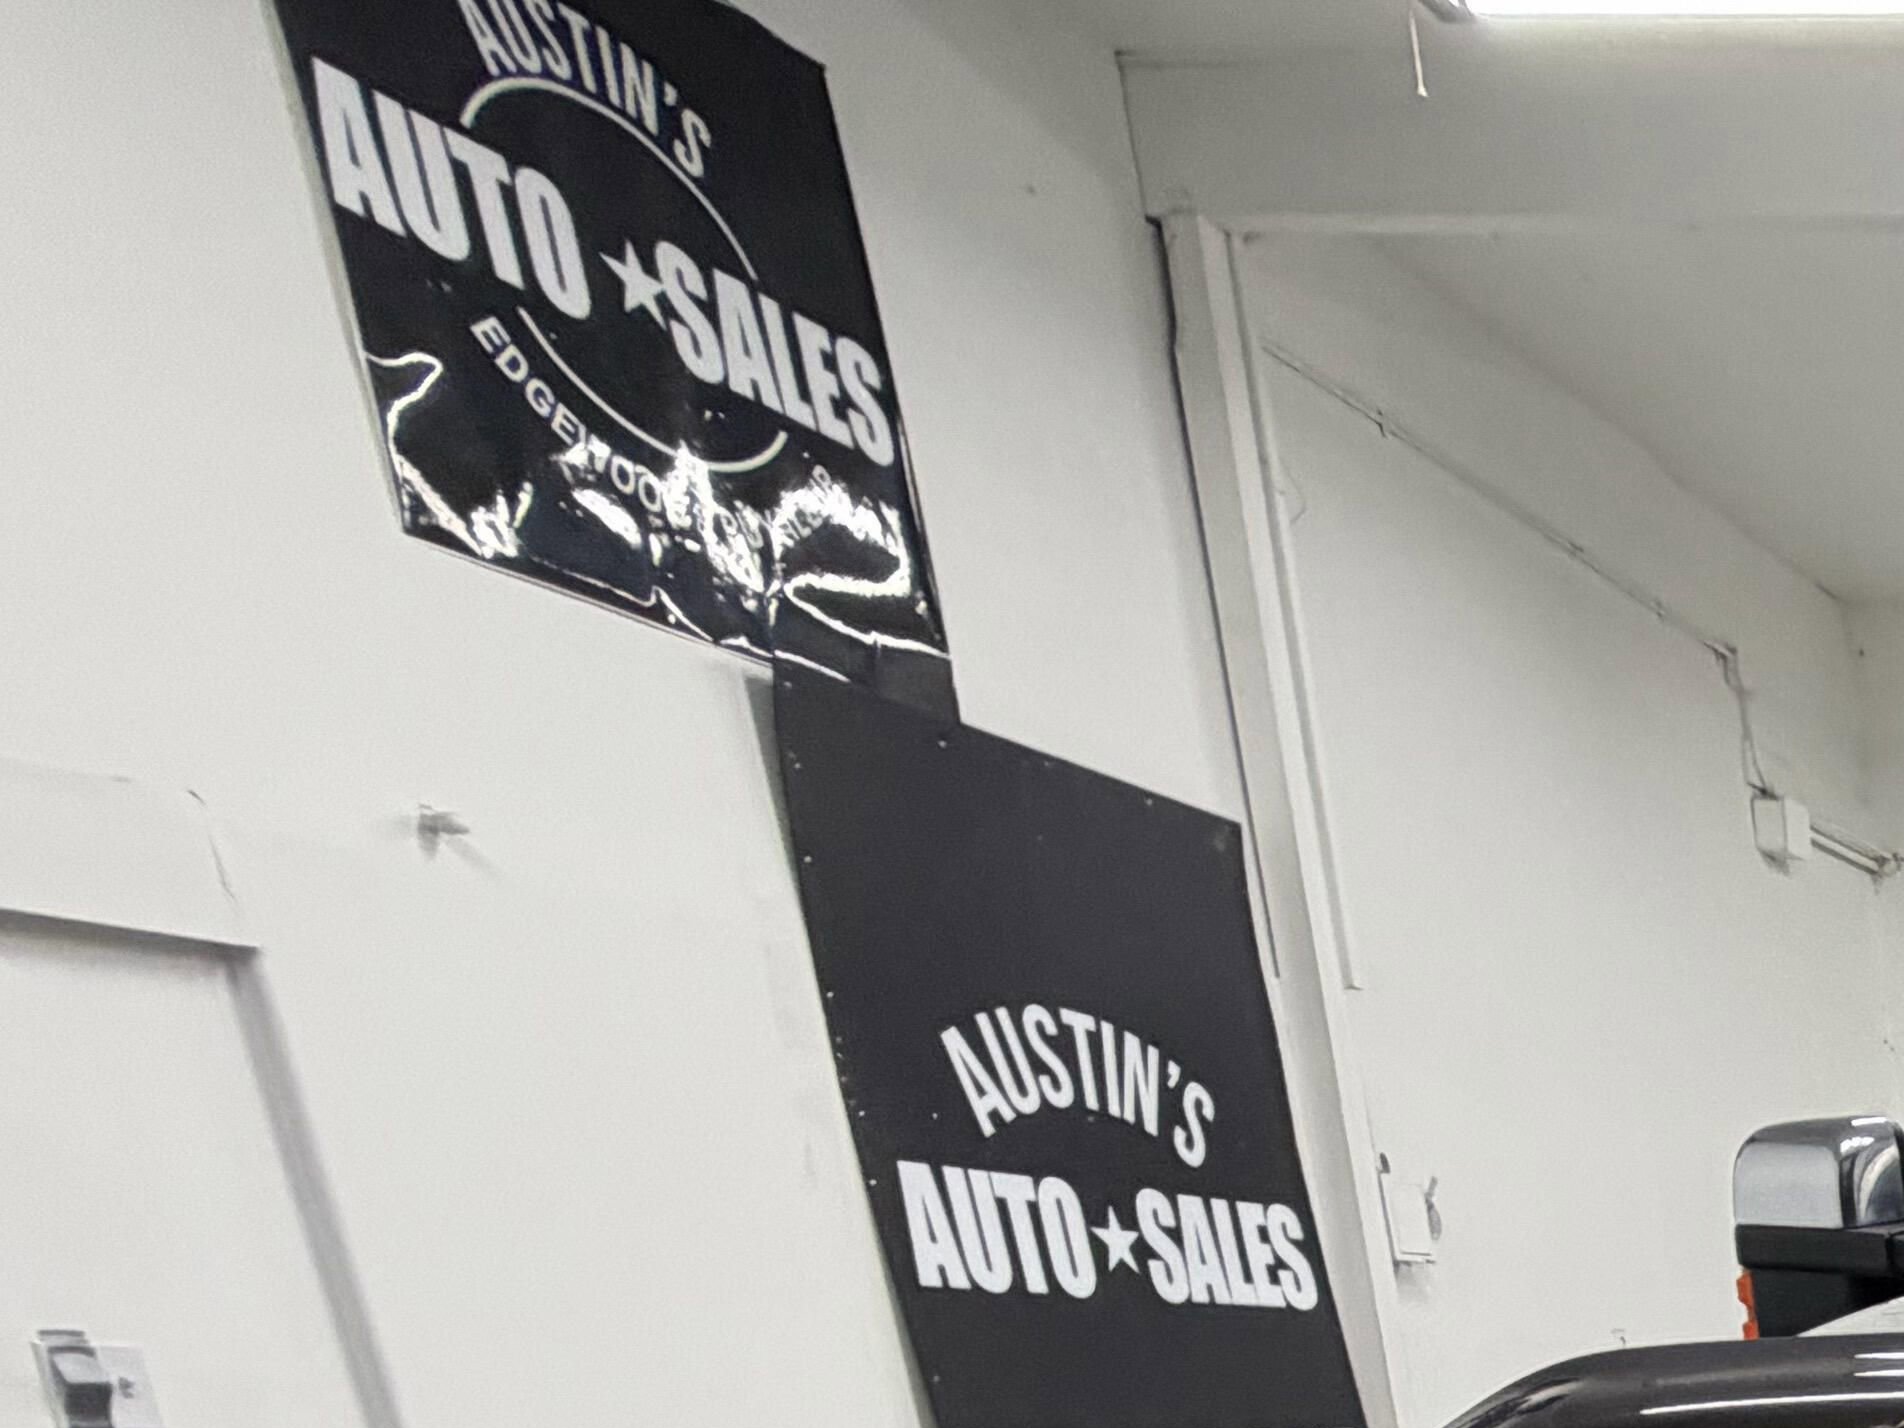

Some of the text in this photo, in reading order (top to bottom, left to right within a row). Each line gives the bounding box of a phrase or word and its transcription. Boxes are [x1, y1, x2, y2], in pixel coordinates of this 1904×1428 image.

[458, 0, 712, 178] AUSTIN'S
[311, 56, 894, 468] AUTO SALES
[940, 1004, 1215, 1168] AUSTIN'S
[897, 1160, 1319, 1312] AUTO SALES
